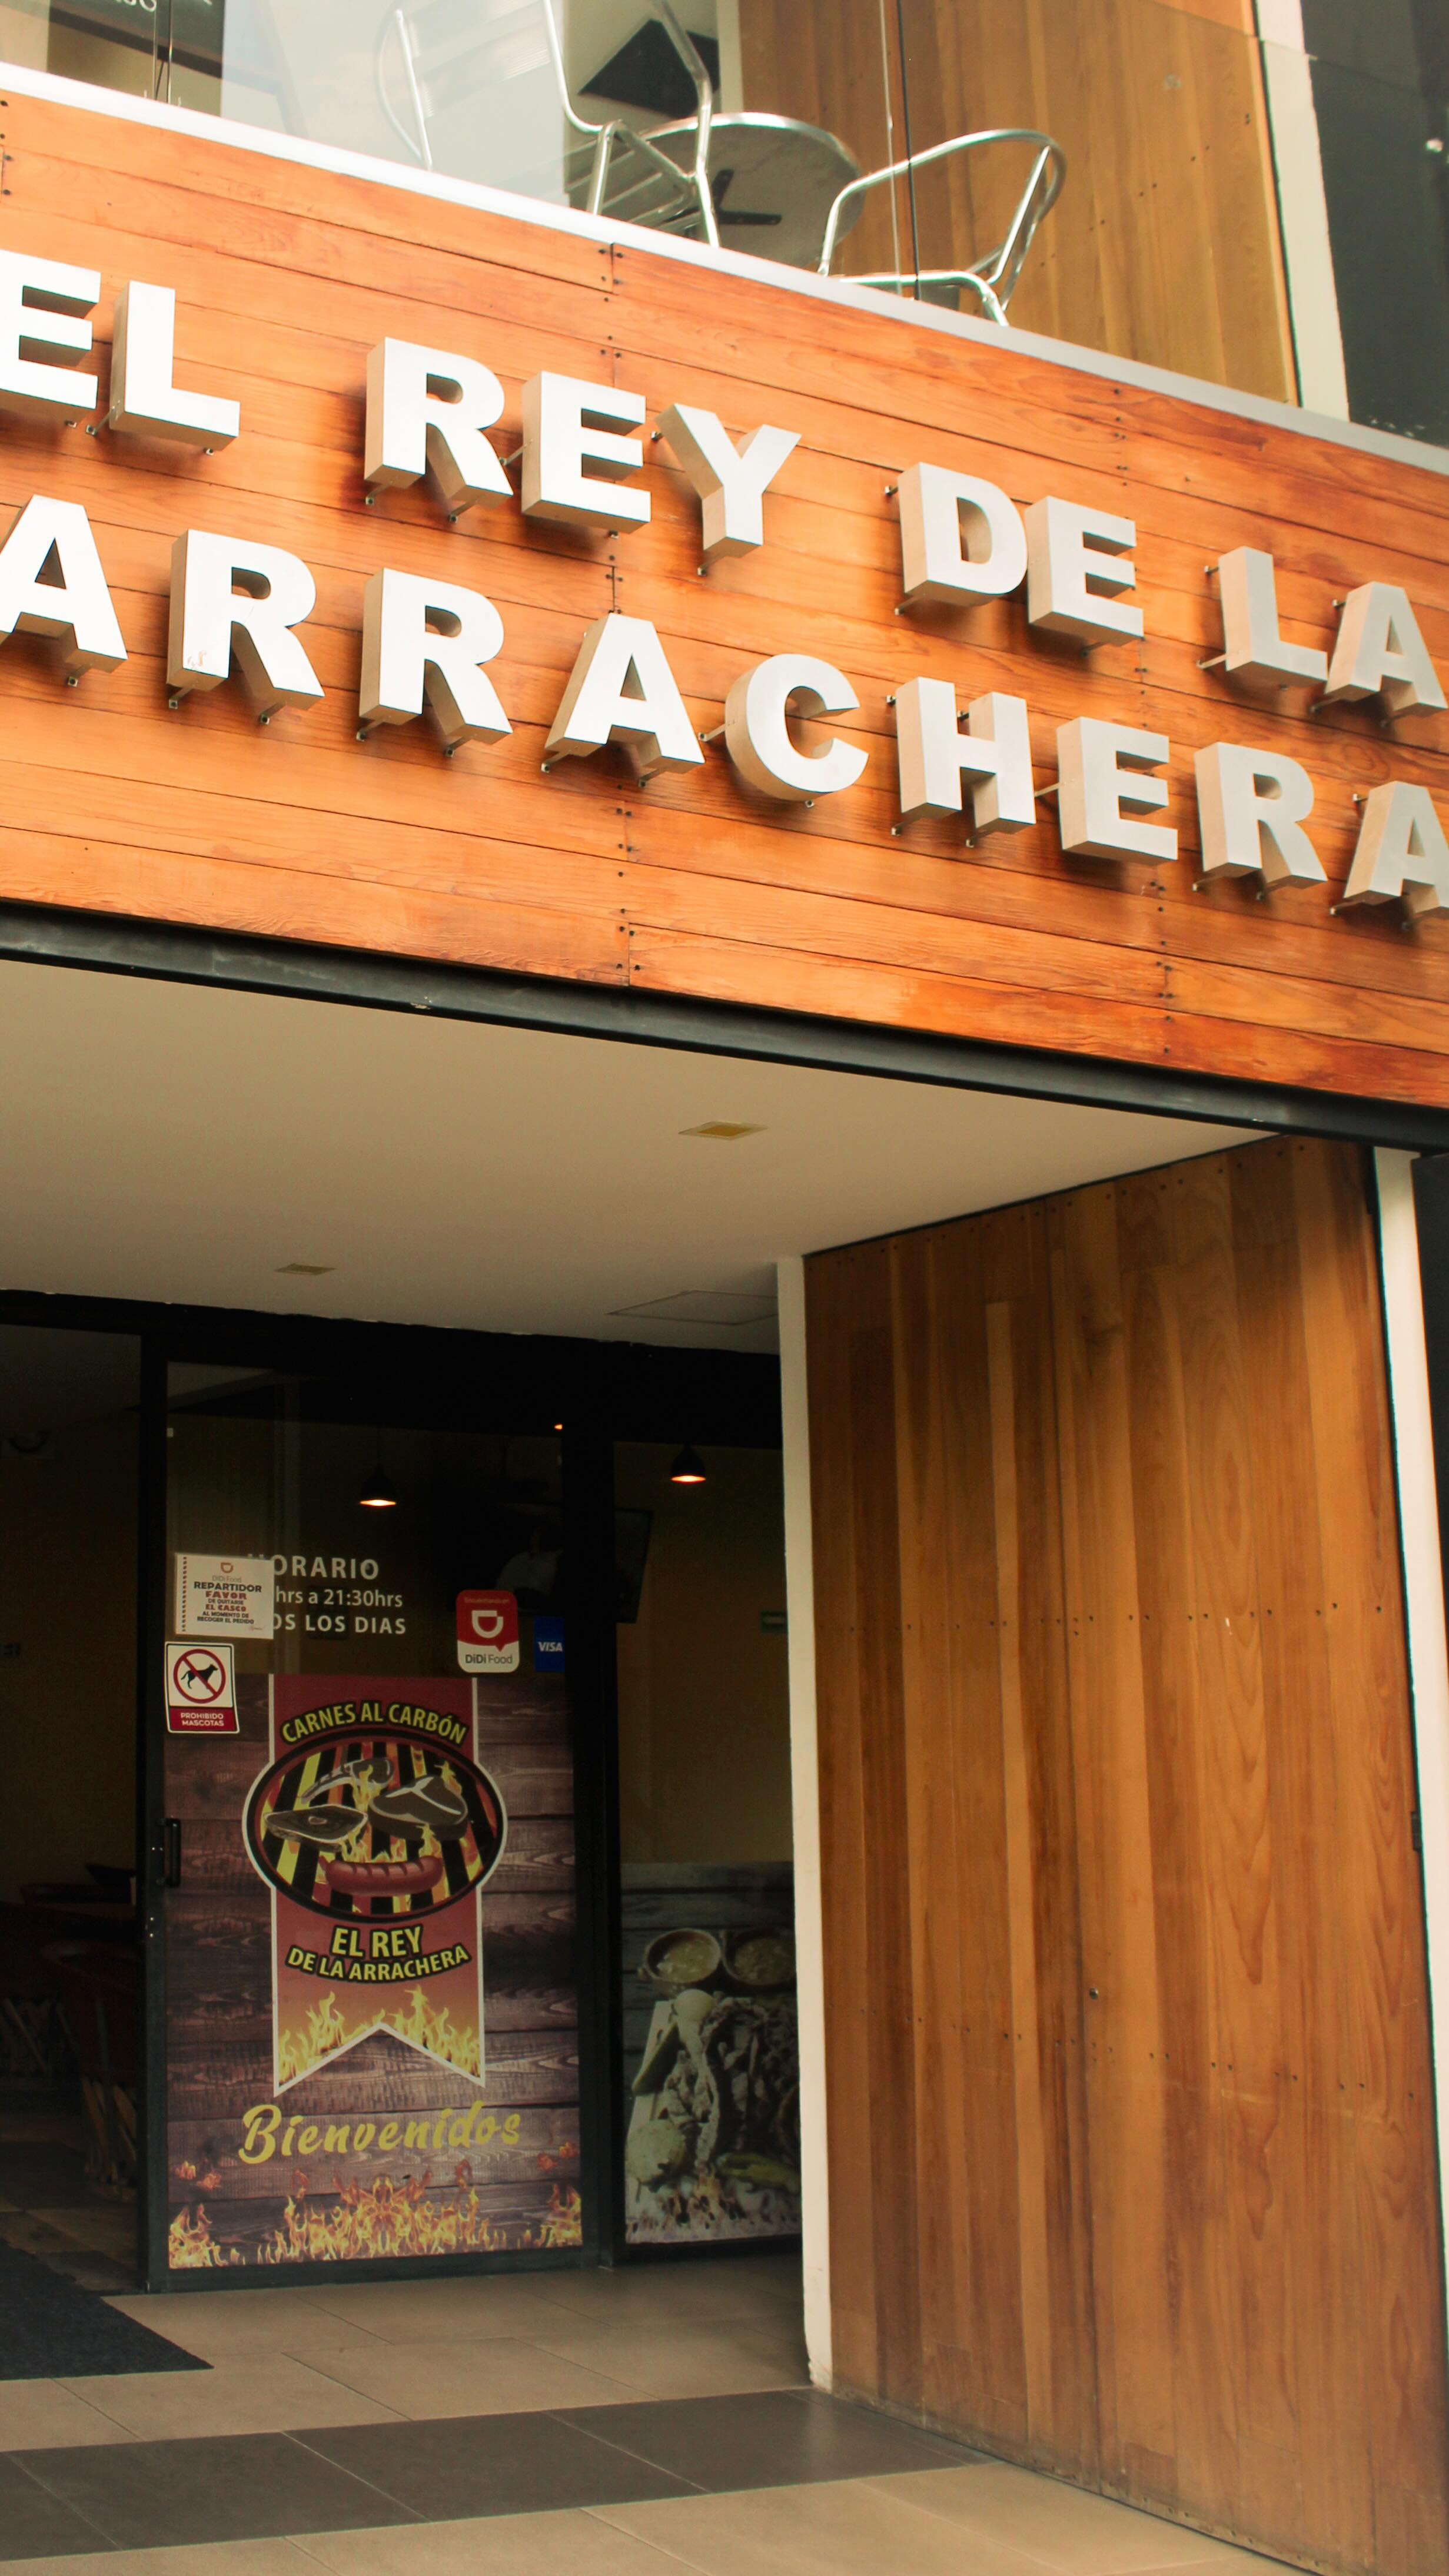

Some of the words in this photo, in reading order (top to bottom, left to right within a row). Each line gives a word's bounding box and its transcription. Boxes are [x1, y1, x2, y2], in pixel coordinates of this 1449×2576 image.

[0, 250, 240, 450] EL
[365, 336, 802, 560] REY
[898, 462, 1144, 645] DE
[1217, 546, 1448, 719] LA
[0, 494, 1449, 918] ARRACHERA
[248, 1554, 378, 1580] ORARIO
[194, 1581, 262, 1592] REPARTIDOR
[205, 1591, 247, 1599] FAVOR
[308, 1592, 318, 1604] a
[324, 1589, 403, 1607] 21:30hrs
[305, 1615, 346, 1632] LOS
[355, 1616, 406, 1634] DIAS
[465, 1654, 487, 1664] DiDi
[488, 1654, 513, 1665] Food
[538, 1641, 563, 1652] VISA
[282, 1704, 355, 1743] CARNES
[361, 1702, 384, 1722] AL
[388, 1704, 467, 1744] CARBÓN
[331, 1927, 364, 1957] EL
[371, 1926, 422, 1958] REY
[288, 1947, 316, 1971] DE
[319, 1957, 344, 1979] LA
[348, 1945, 470, 1981] ARRACHERA
[238, 2100, 521, 2165] Bienvenidos
